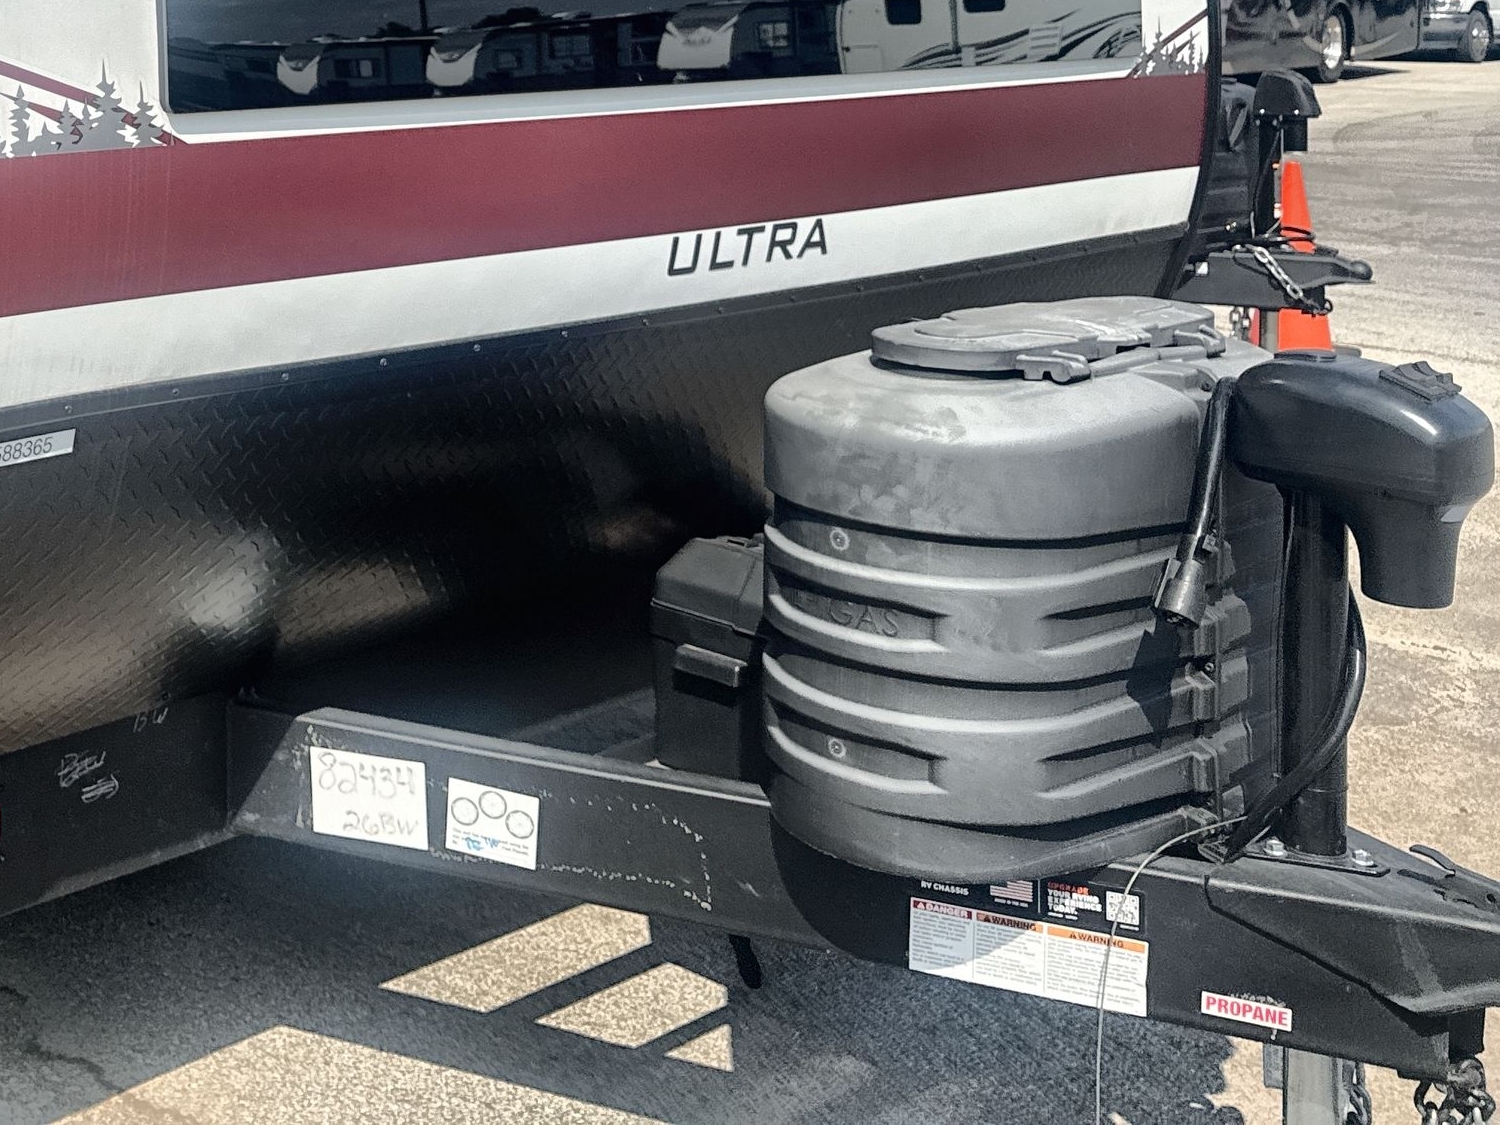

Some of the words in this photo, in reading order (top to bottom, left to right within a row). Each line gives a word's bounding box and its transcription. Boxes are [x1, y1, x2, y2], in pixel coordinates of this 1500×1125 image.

[666, 217, 827, 277] ULTRA
[318, 751, 415, 799] 82434
[920, 880, 932, 889] RV
[933, 881, 969, 896] CHASSIS
[1047, 888, 1071, 899] YOUR
[926, 901, 968, 919] DANGER
[1047, 895, 1102, 913] EXPERIENCE
[991, 915, 1037, 933] WARNING
[1205, 995, 1288, 1027] PROPANE
